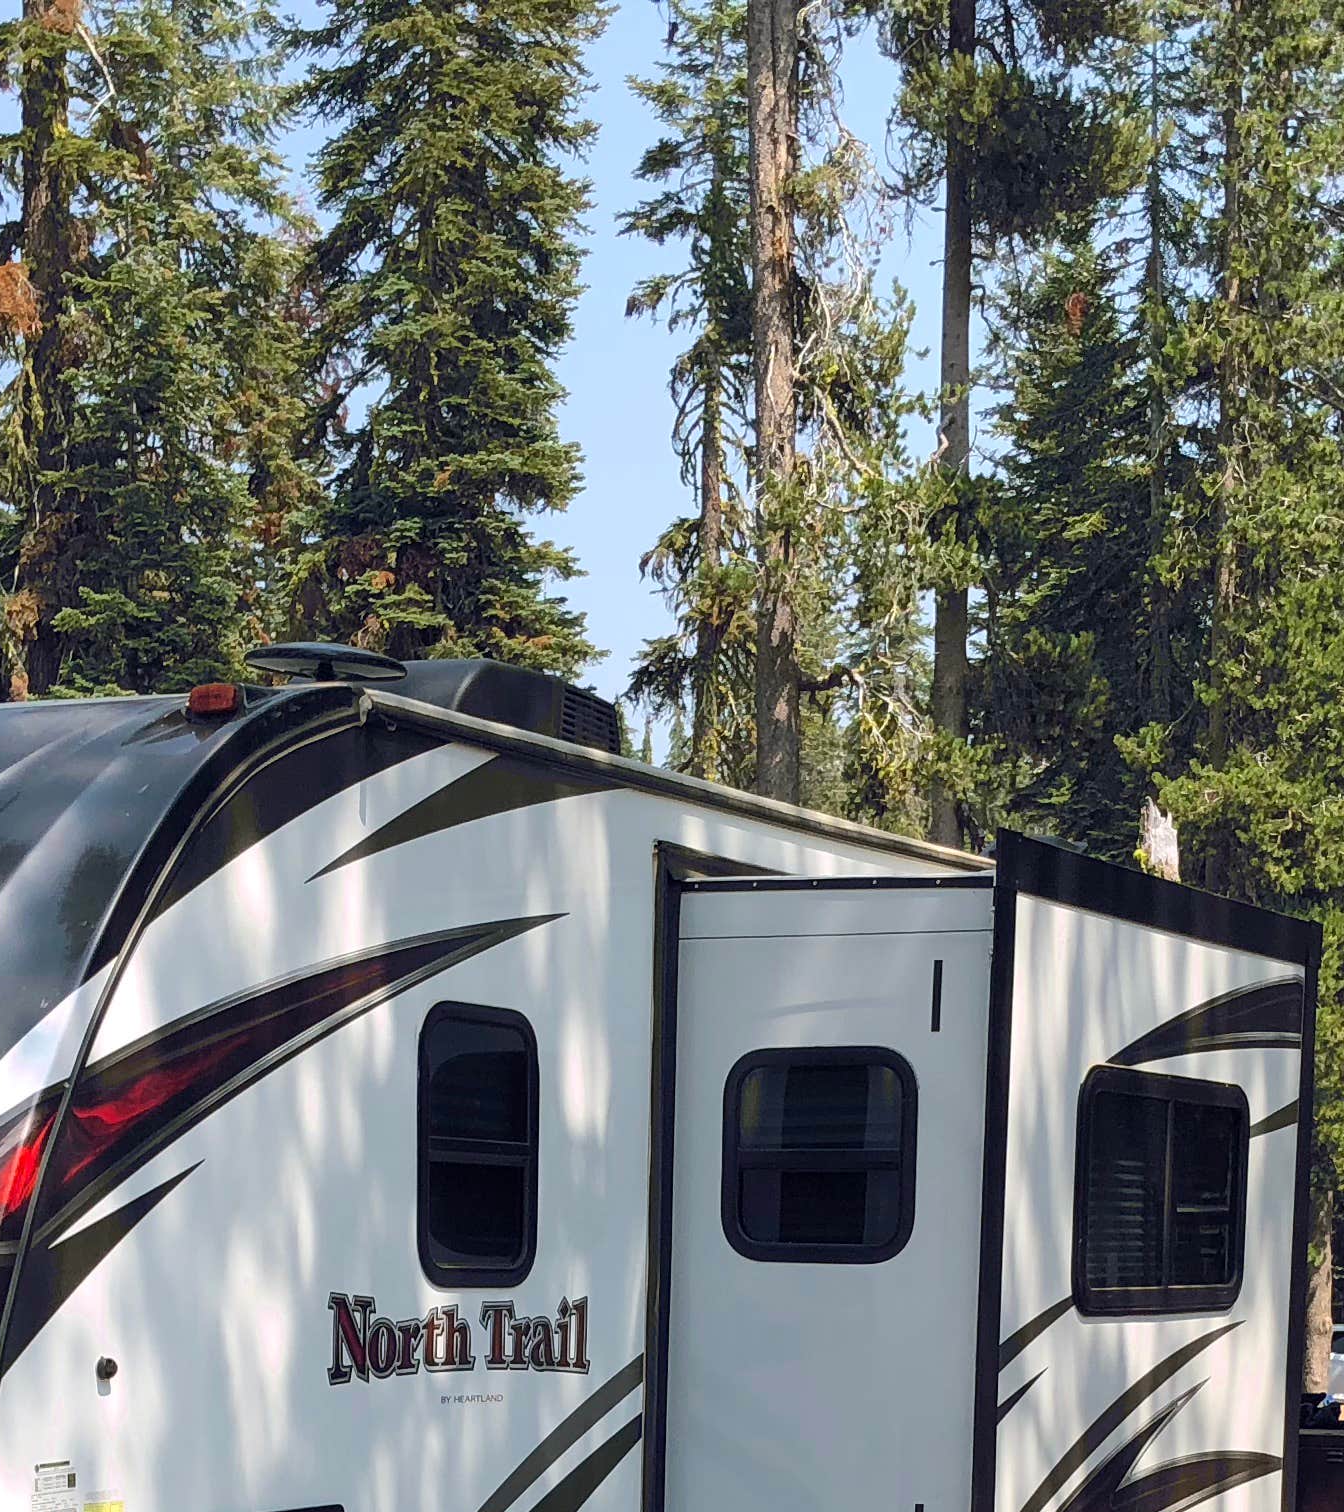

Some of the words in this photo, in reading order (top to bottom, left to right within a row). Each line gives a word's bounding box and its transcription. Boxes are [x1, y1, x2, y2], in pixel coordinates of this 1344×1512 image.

[327, 1291, 476, 1385] North
[479, 1296, 591, 1375] Trail
[440, 1395, 451, 1404] BY
[453, 1393, 504, 1404] HEARTLAND
